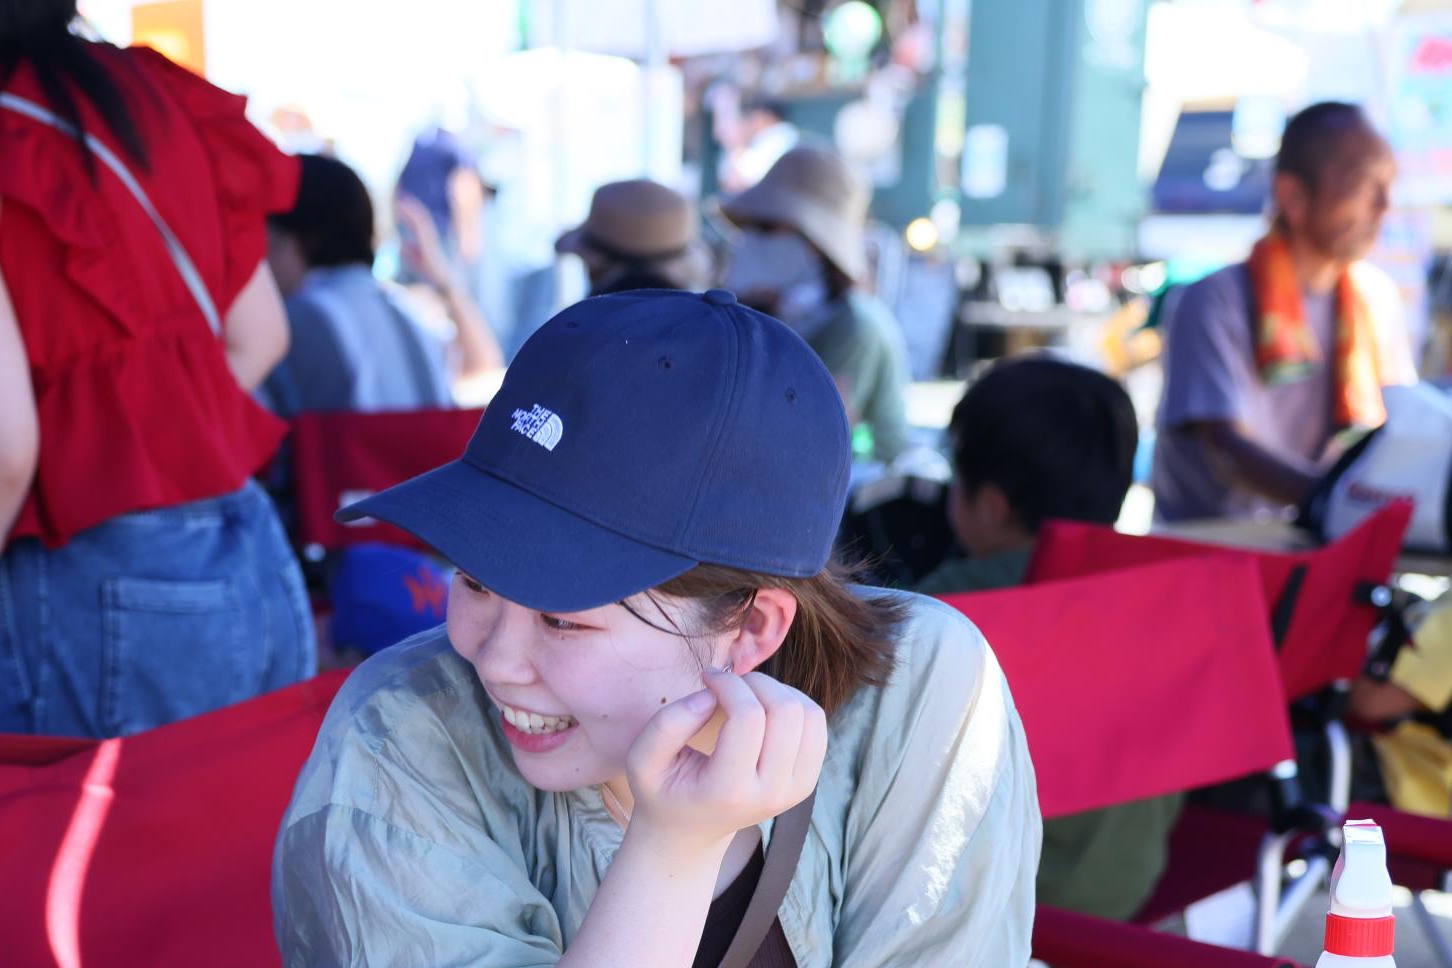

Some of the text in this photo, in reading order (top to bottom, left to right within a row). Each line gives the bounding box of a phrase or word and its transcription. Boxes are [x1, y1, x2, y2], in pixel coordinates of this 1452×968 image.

[511, 408, 544, 430] NORTH
[530, 403, 552, 421] THE
[511, 419, 538, 438] FACE
